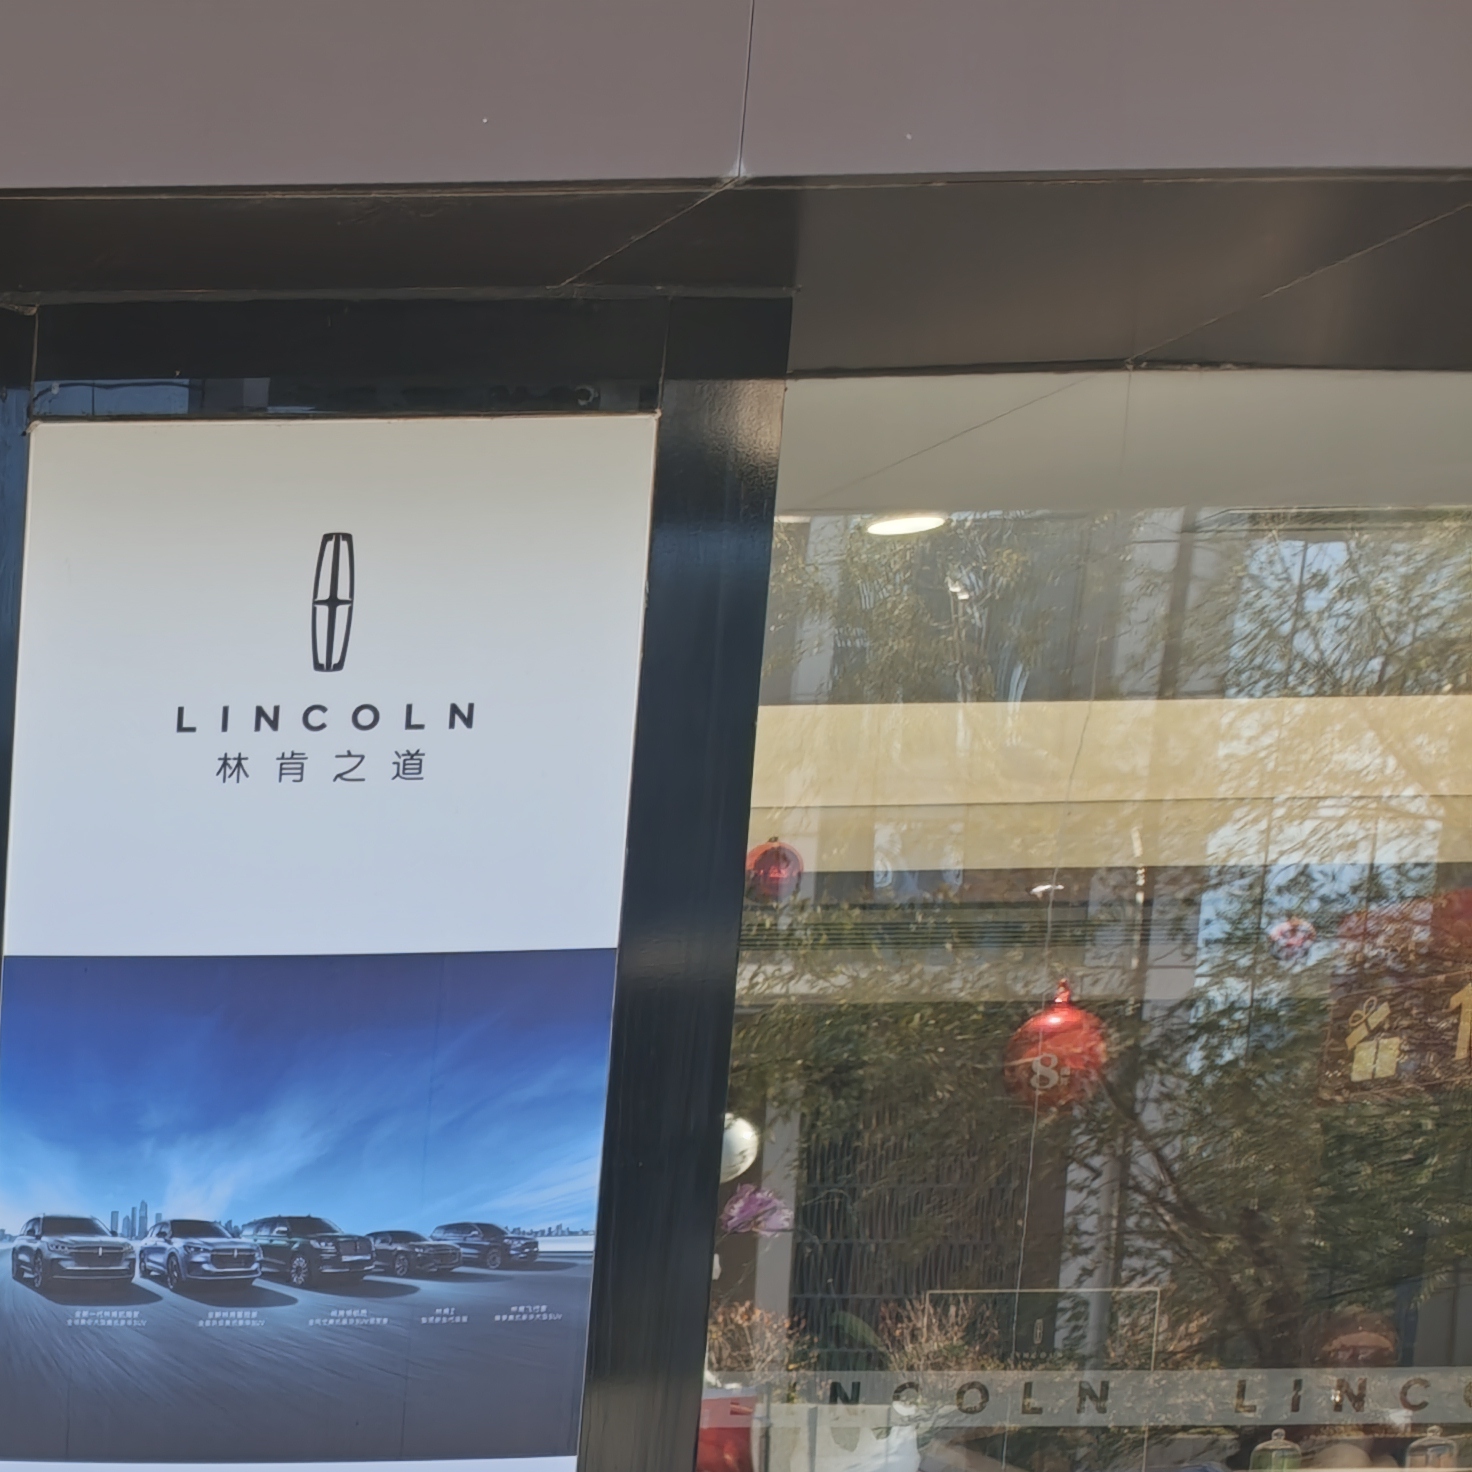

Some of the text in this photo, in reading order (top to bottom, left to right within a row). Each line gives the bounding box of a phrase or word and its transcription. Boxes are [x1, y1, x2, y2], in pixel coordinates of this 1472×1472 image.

[176, 702, 475, 733] LINCOLN
[215, 749, 426, 784] 林肯之道
[1235, 1377, 1472, 1414] LINC
